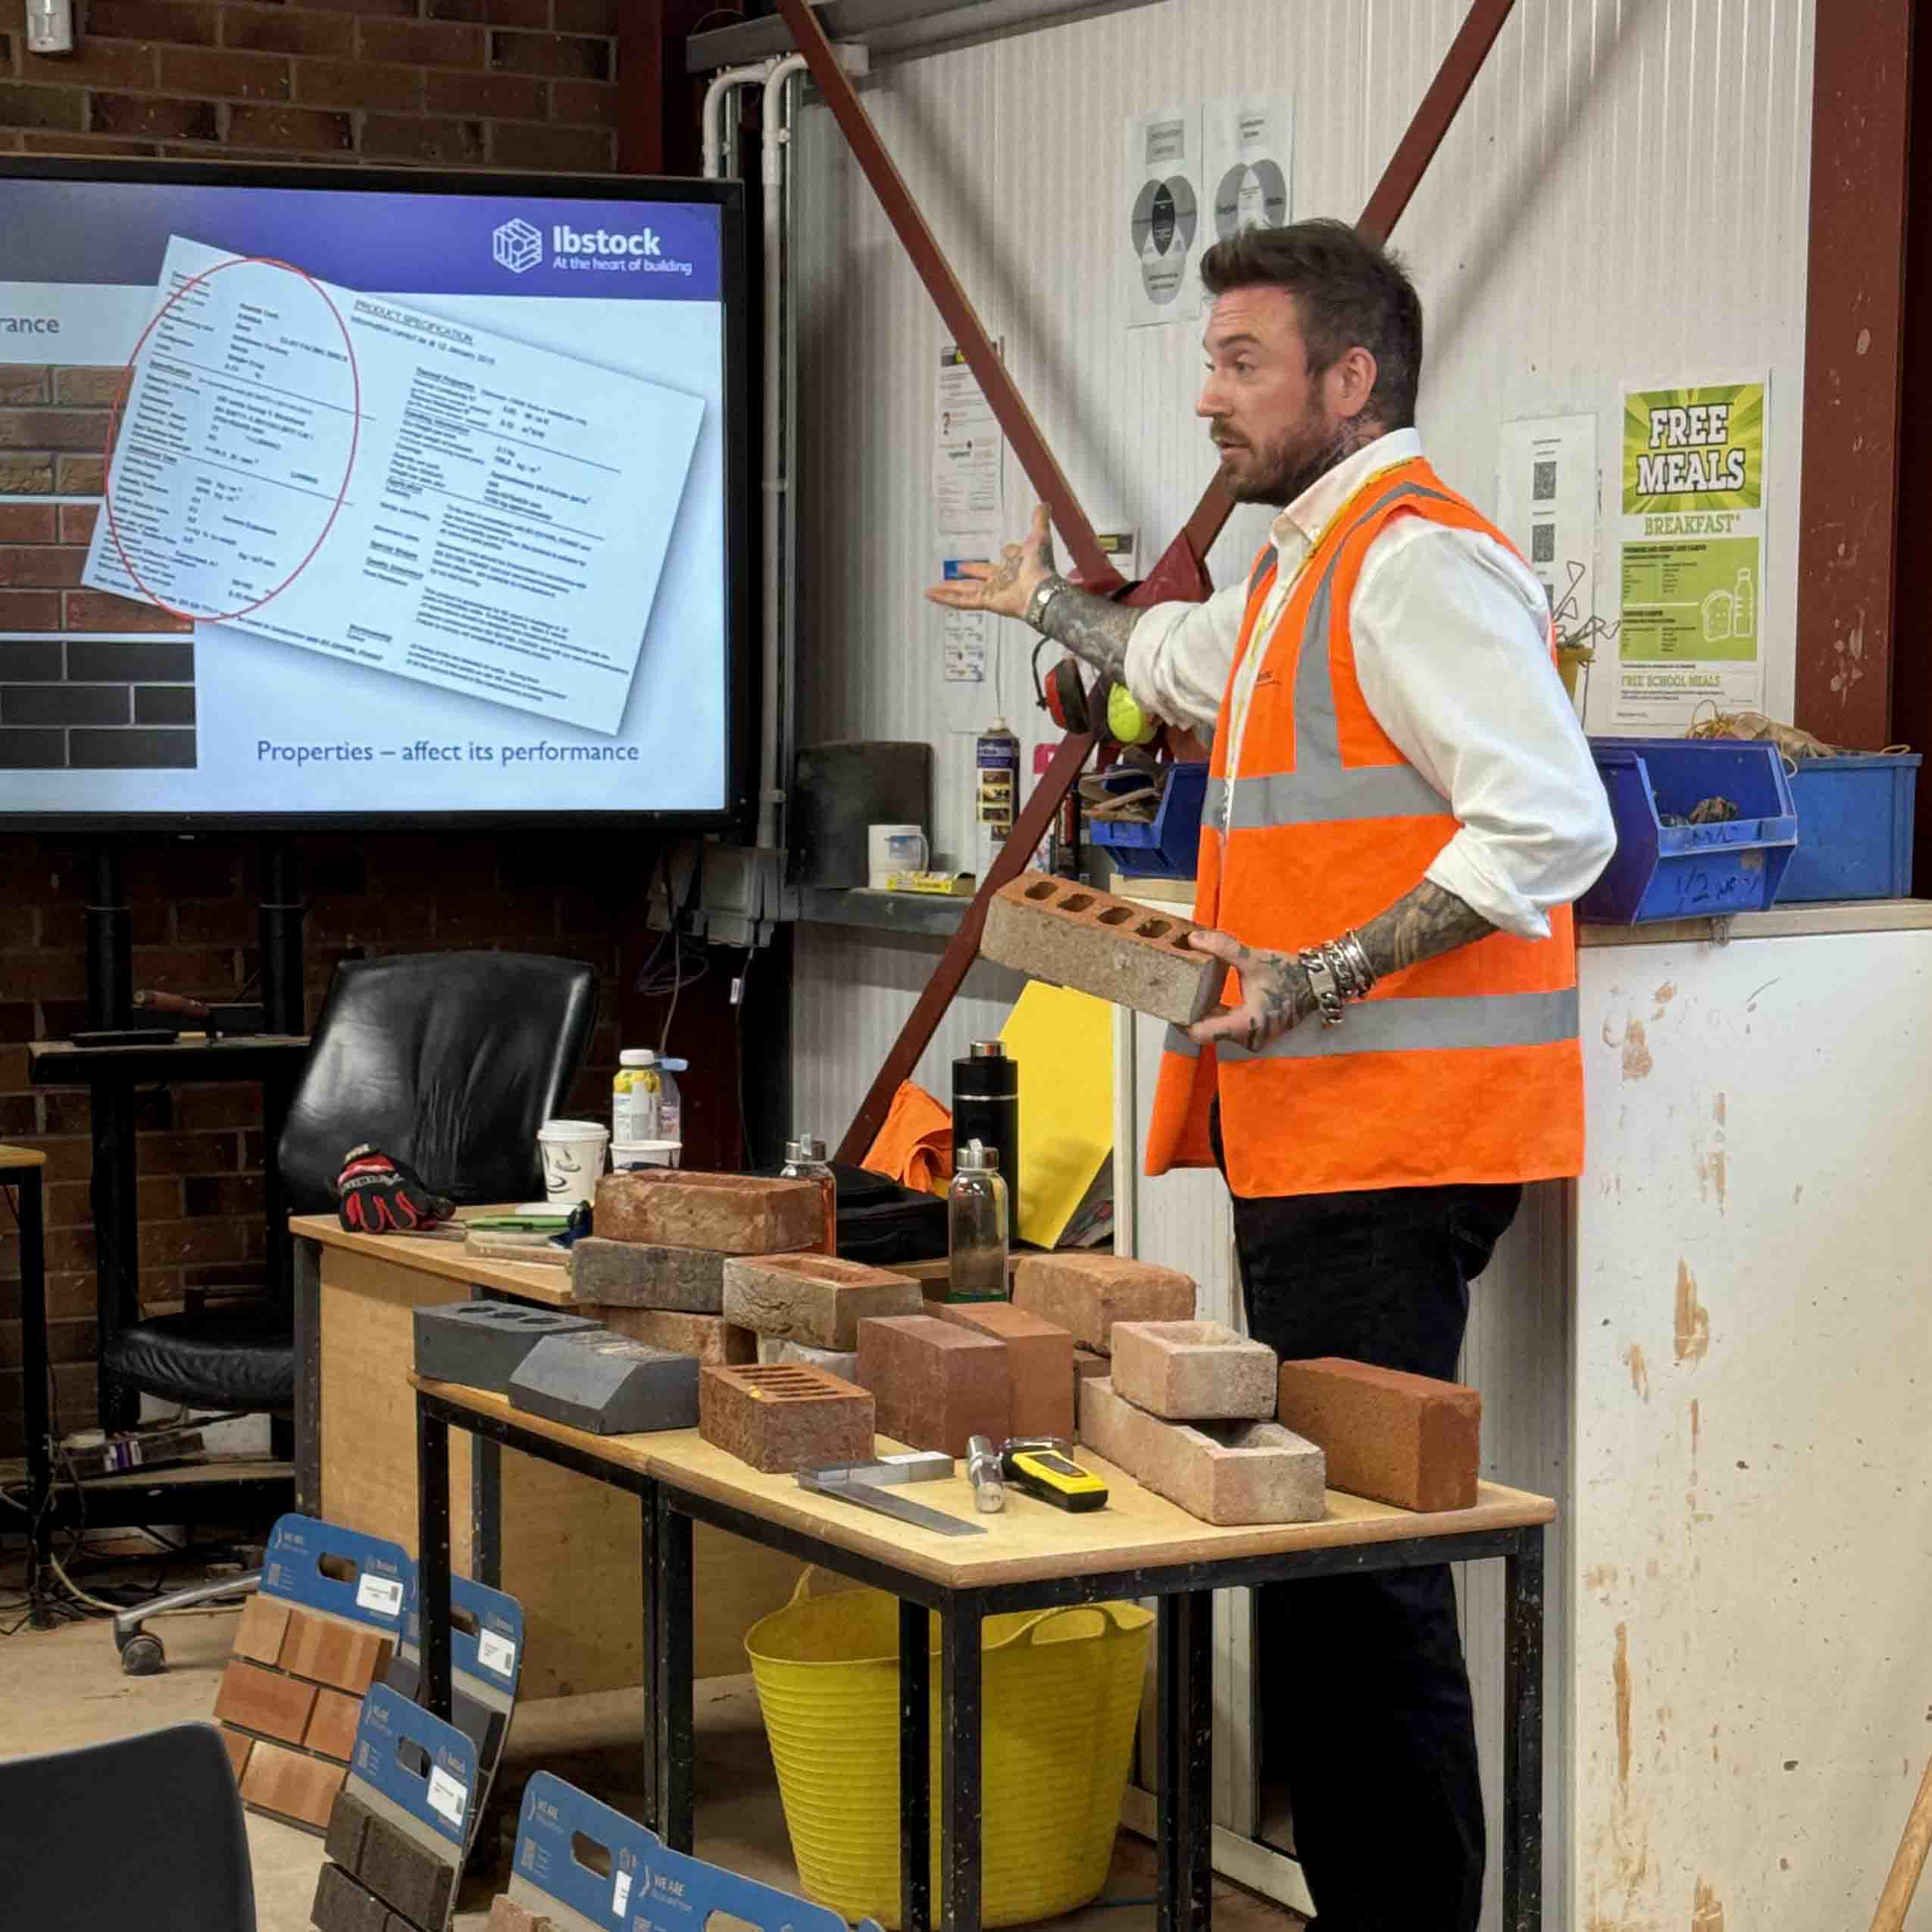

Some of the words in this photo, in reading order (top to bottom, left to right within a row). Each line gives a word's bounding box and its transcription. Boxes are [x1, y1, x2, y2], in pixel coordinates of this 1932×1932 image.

[553, 225, 661, 255] Ibstock
[553, 256, 567, 269] At
[570, 258, 589, 270] the
[593, 258, 626, 271] heart
[628, 259, 642, 271] of
[644, 260, 692, 276] building
[1649, 403, 1731, 449] FREE
[1636, 448, 1746, 496] MEALS
[258, 741, 373, 766] Properties
[402, 740, 461, 760] affect
[469, 741, 493, 760] its
[502, 741, 639, 766] performance
